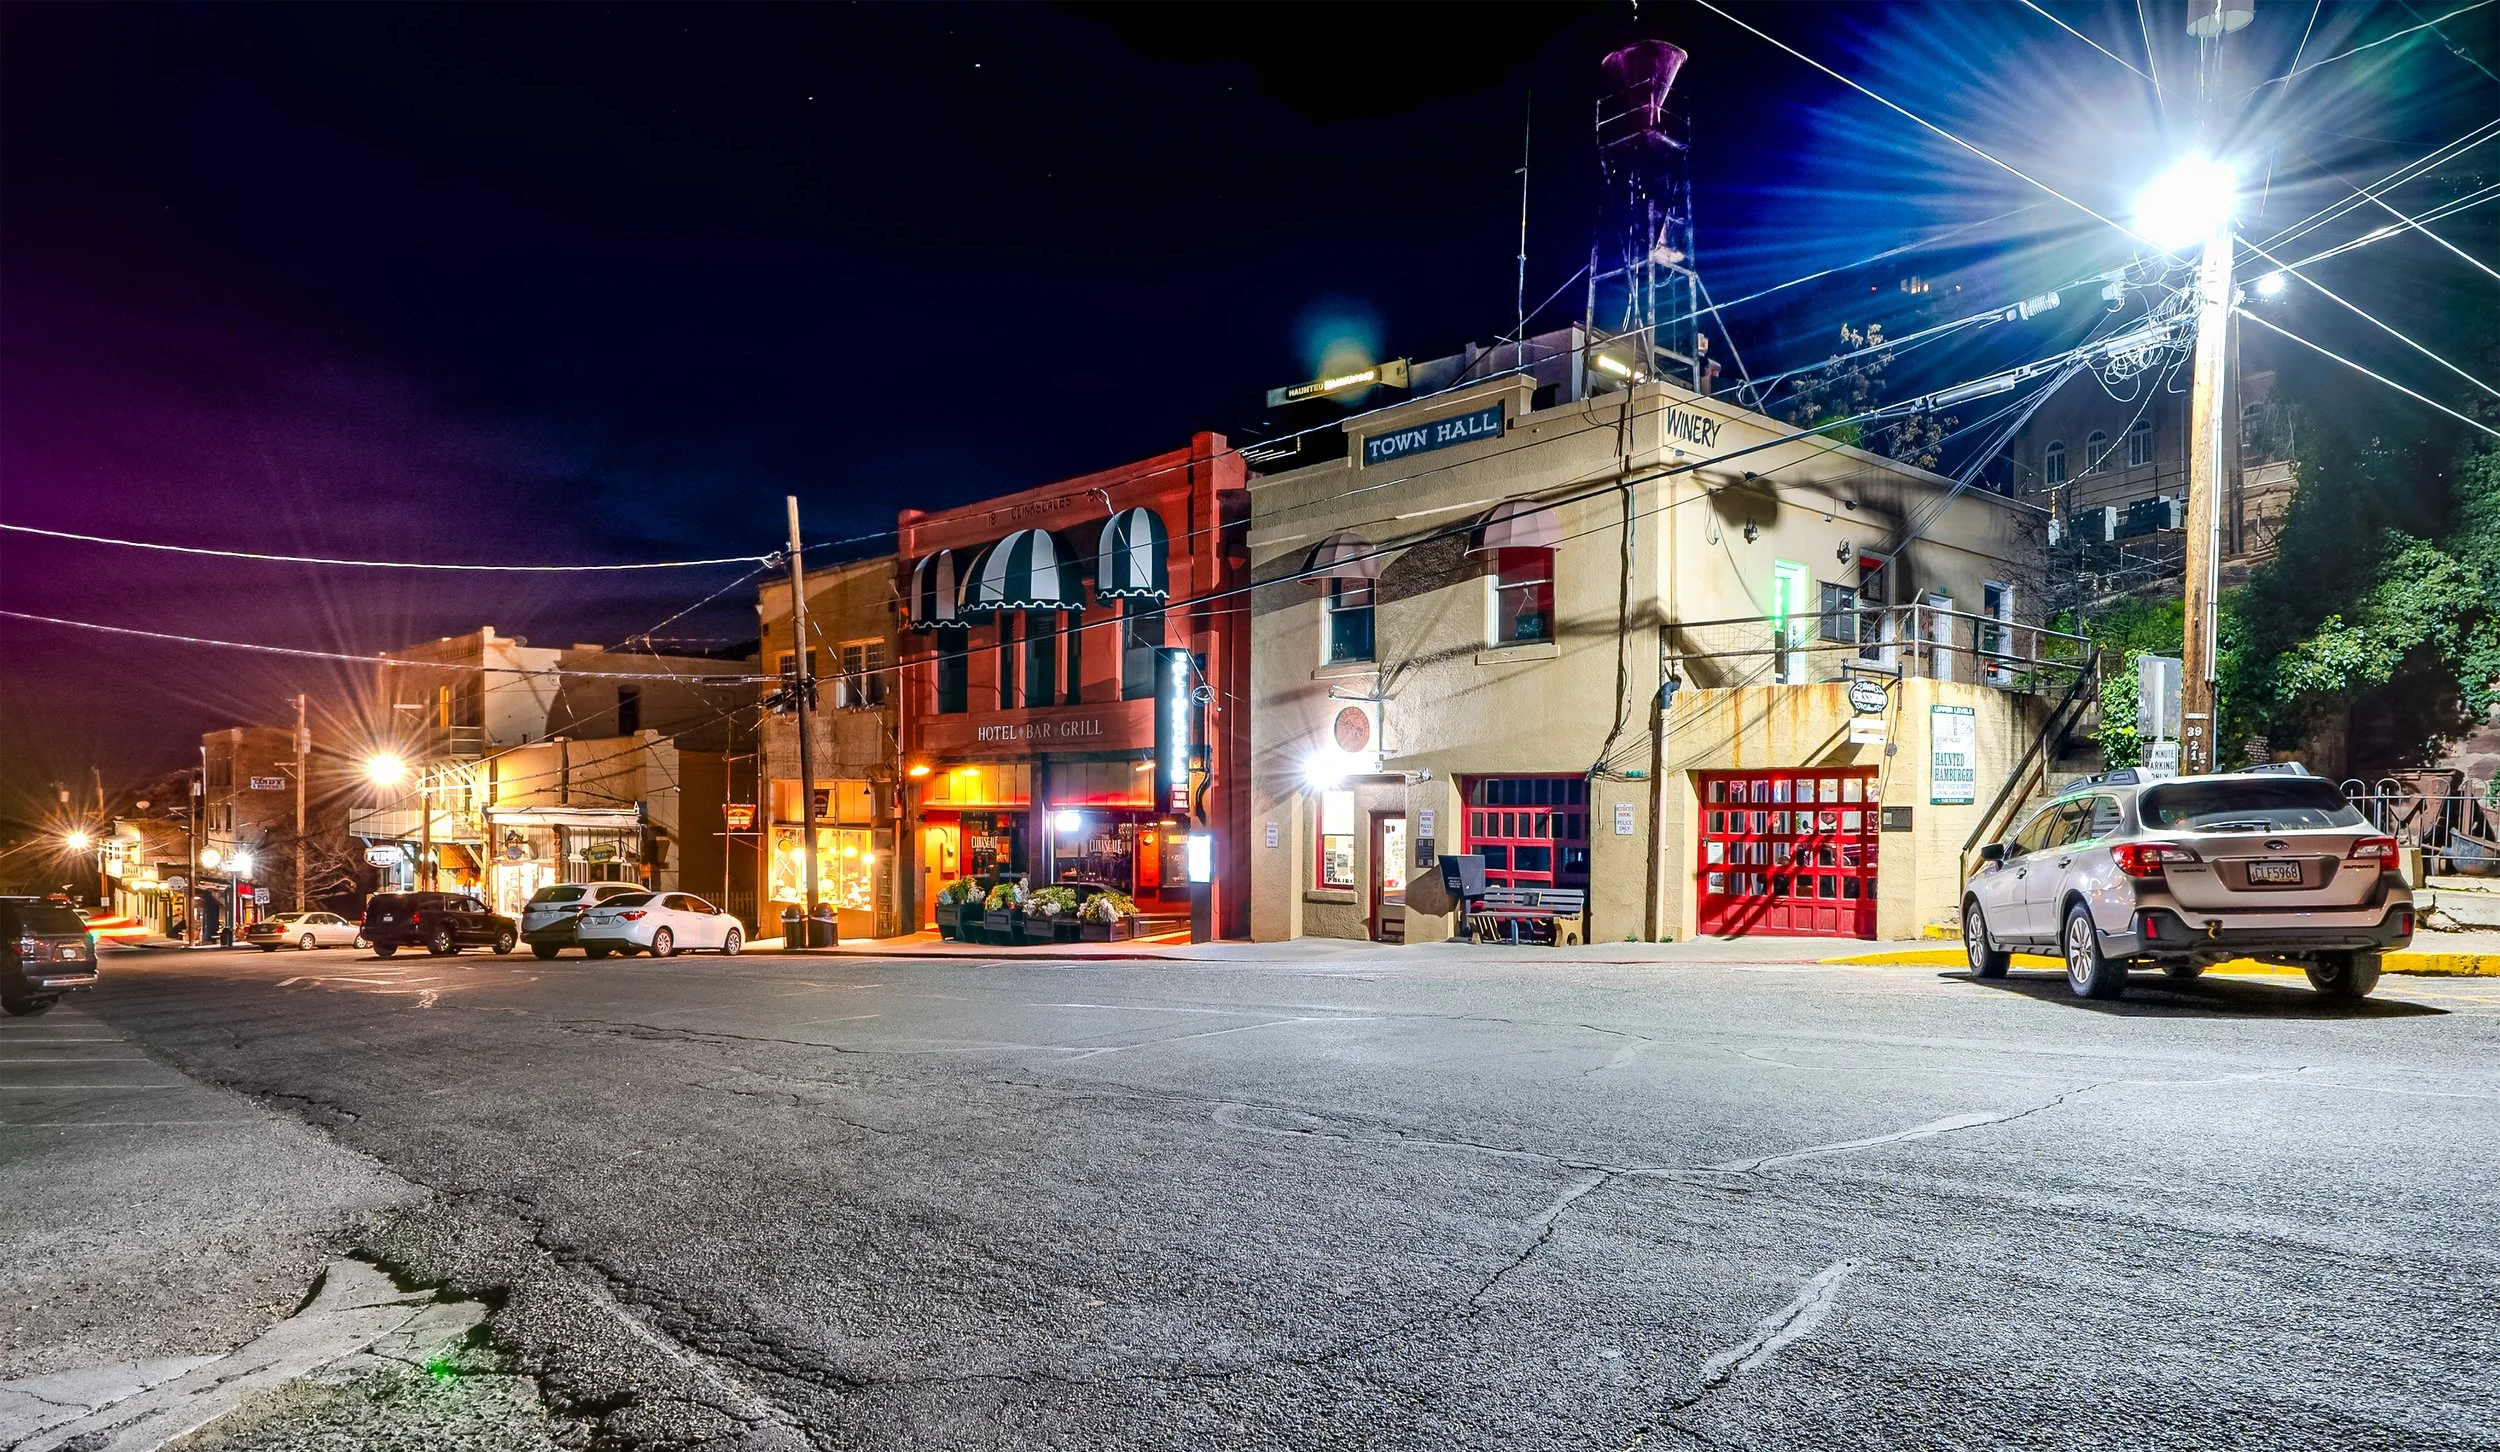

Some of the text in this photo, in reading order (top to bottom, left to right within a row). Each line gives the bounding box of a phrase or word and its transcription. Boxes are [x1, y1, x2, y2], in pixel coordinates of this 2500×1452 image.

[1667, 407, 1721, 448] WINERY
[1369, 413, 1497, 457] TOWN HALL
[978, 719, 1103, 741] HOTEL BAR GRILL
[2187, 726, 2202, 736] 39
[2190, 740, 2199, 750] 2
[1935, 752, 1965, 766] HAUNTED
[2156, 749, 2174, 759] MINUTE
[2145, 761, 2175, 770] PARKING
[1935, 768, 1974, 782] HAMBURGER
[2255, 866, 2298, 879] CLF5968
